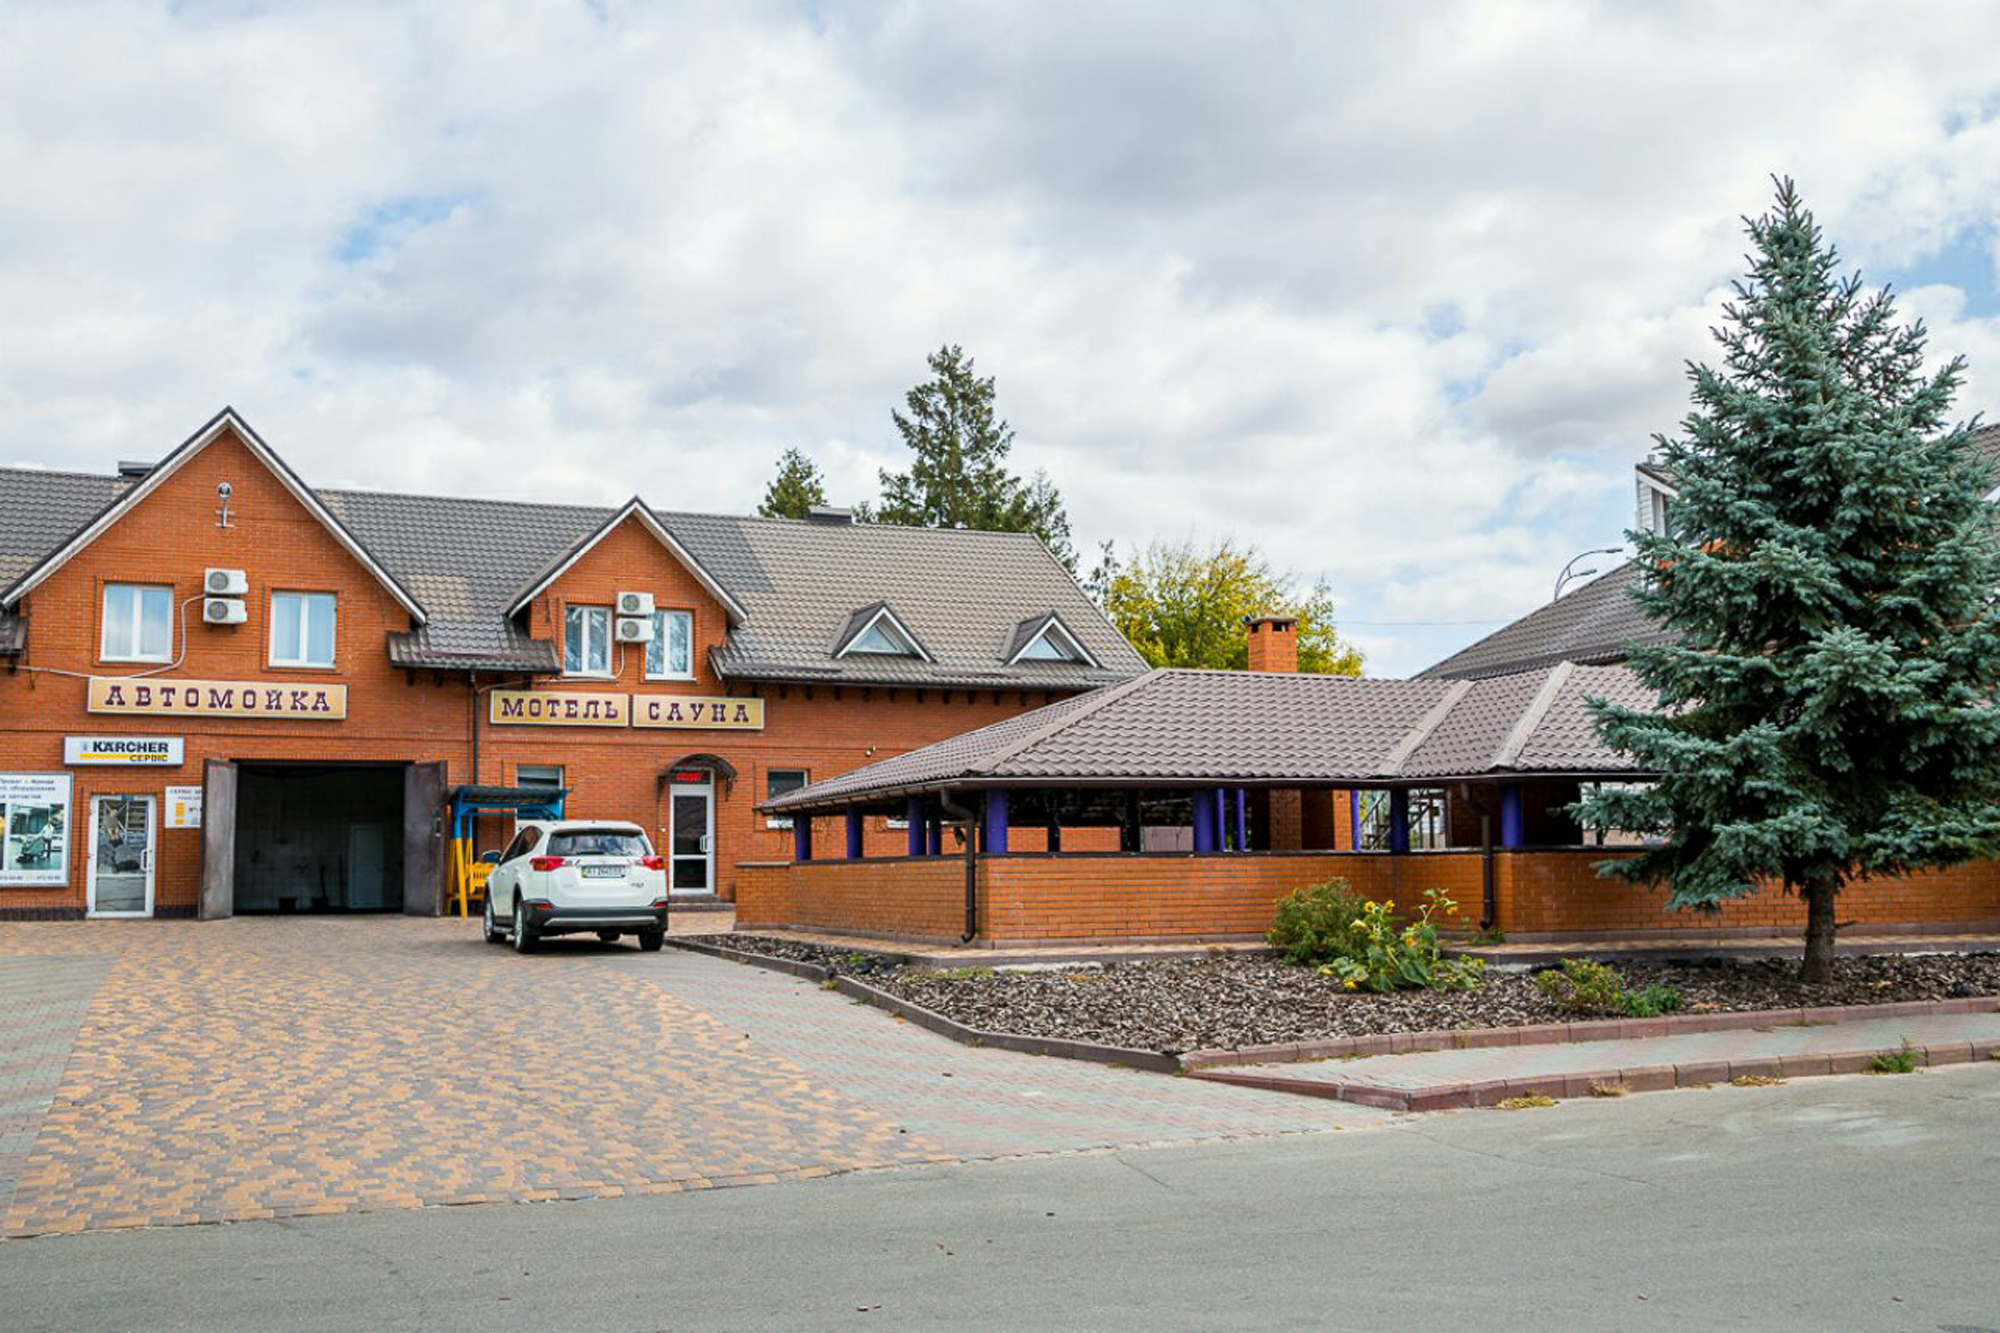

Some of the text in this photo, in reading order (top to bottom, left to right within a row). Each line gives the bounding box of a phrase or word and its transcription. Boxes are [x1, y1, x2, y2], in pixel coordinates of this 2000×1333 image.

[105, 685, 330, 712] АВТОМОЙКА
[501, 698, 619, 719] МОТЕЛЬ
[648, 702, 749, 722] САУНА
